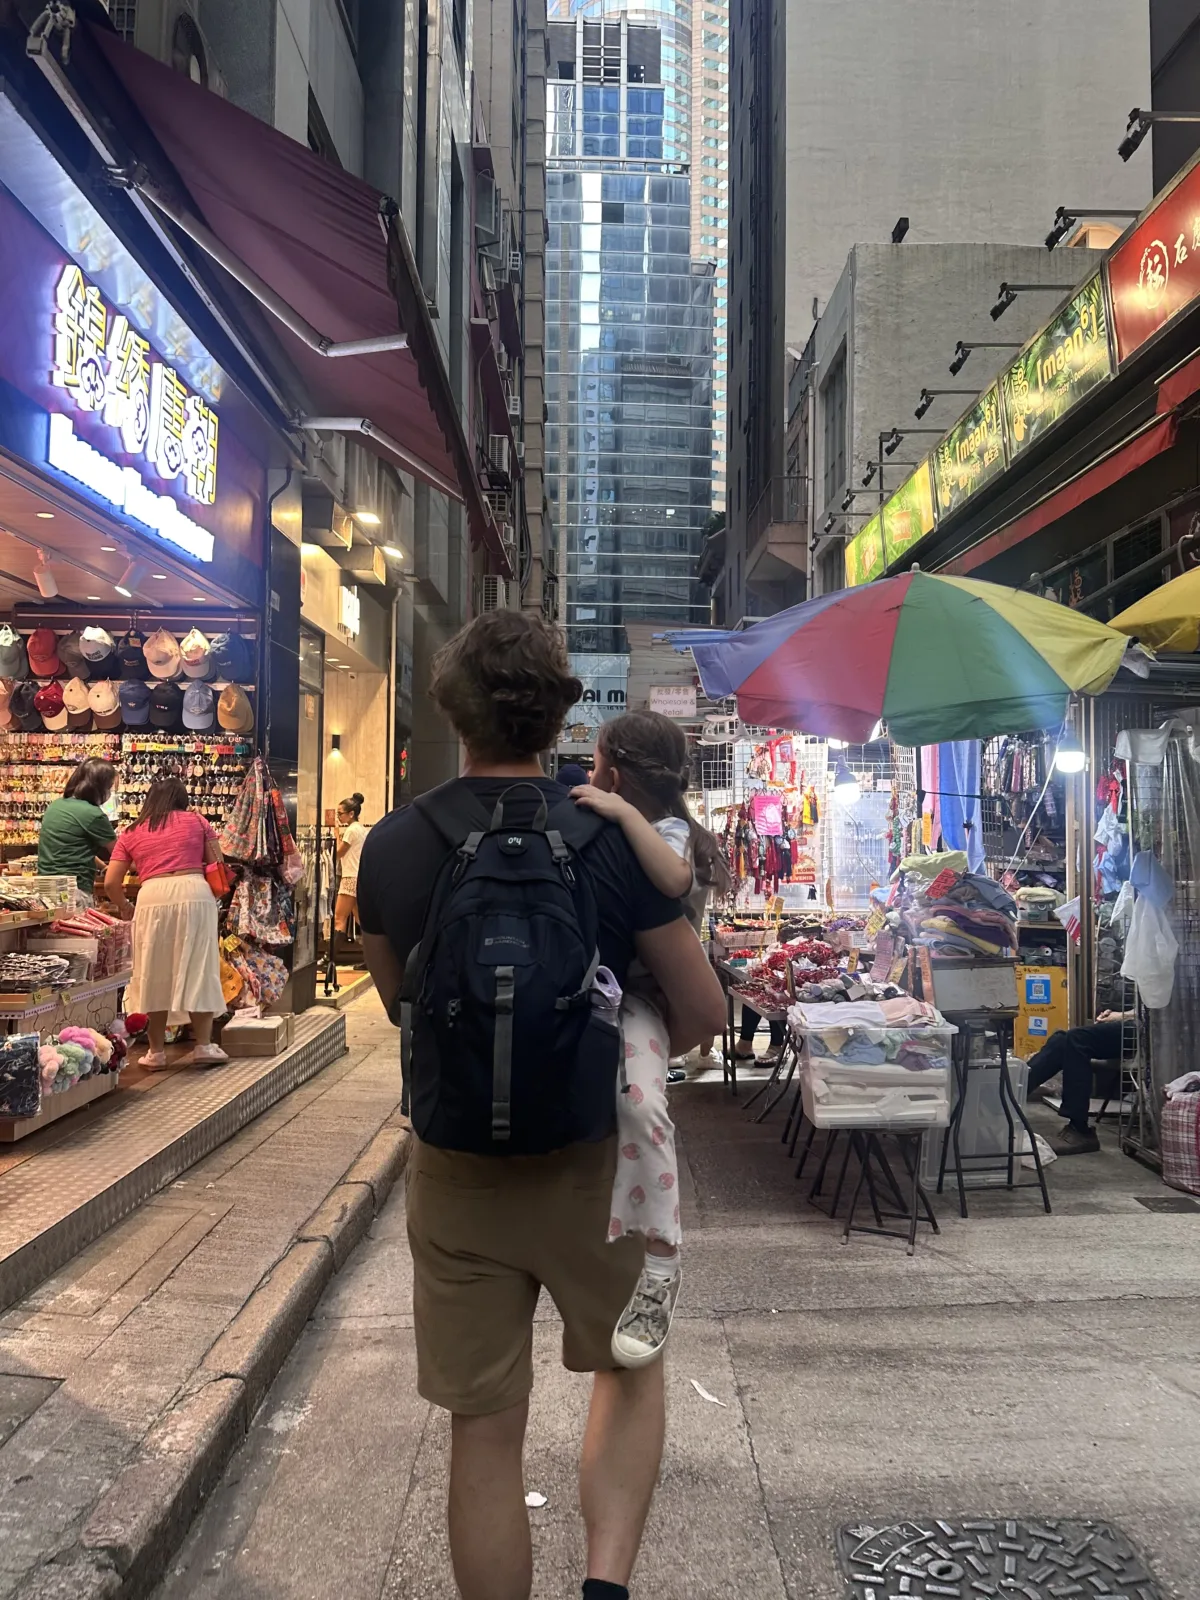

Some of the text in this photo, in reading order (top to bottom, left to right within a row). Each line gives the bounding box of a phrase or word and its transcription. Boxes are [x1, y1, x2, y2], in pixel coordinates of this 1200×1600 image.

[657, 687, 689, 696] 批發/零售
[663, 708, 684, 716] Retail
